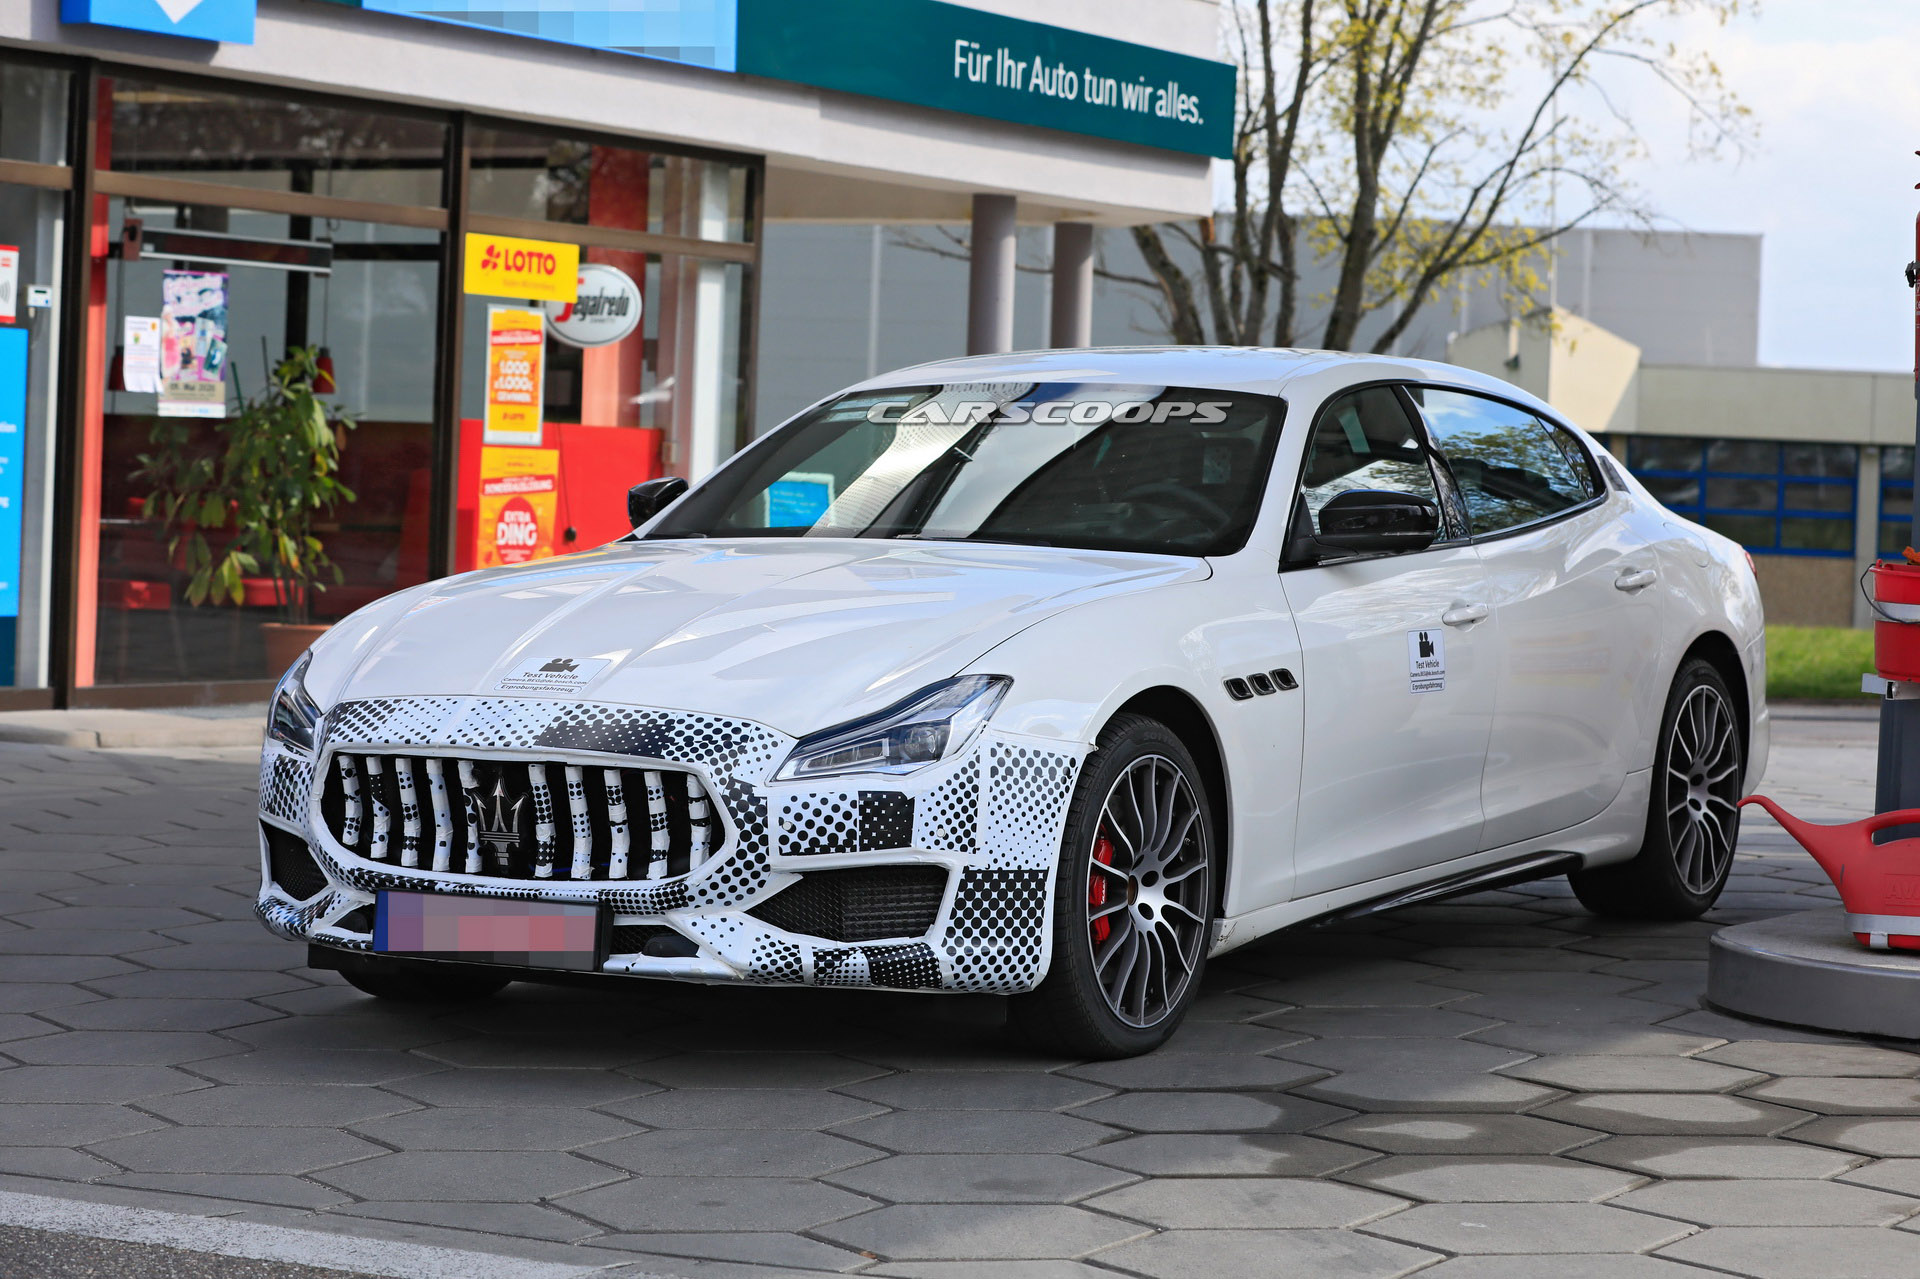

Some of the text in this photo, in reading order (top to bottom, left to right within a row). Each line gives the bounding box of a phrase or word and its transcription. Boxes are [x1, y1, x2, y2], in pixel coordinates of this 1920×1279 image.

[954, 39, 1204, 125] Für Ihr Auto tun wir alles.
[504, 248, 557, 276] LOTTO
[497, 521, 538, 547] DING
[1416, 659, 1439, 669] Test Vehicle
[500, 684, 575, 693] Erprobungsfahrzeug
